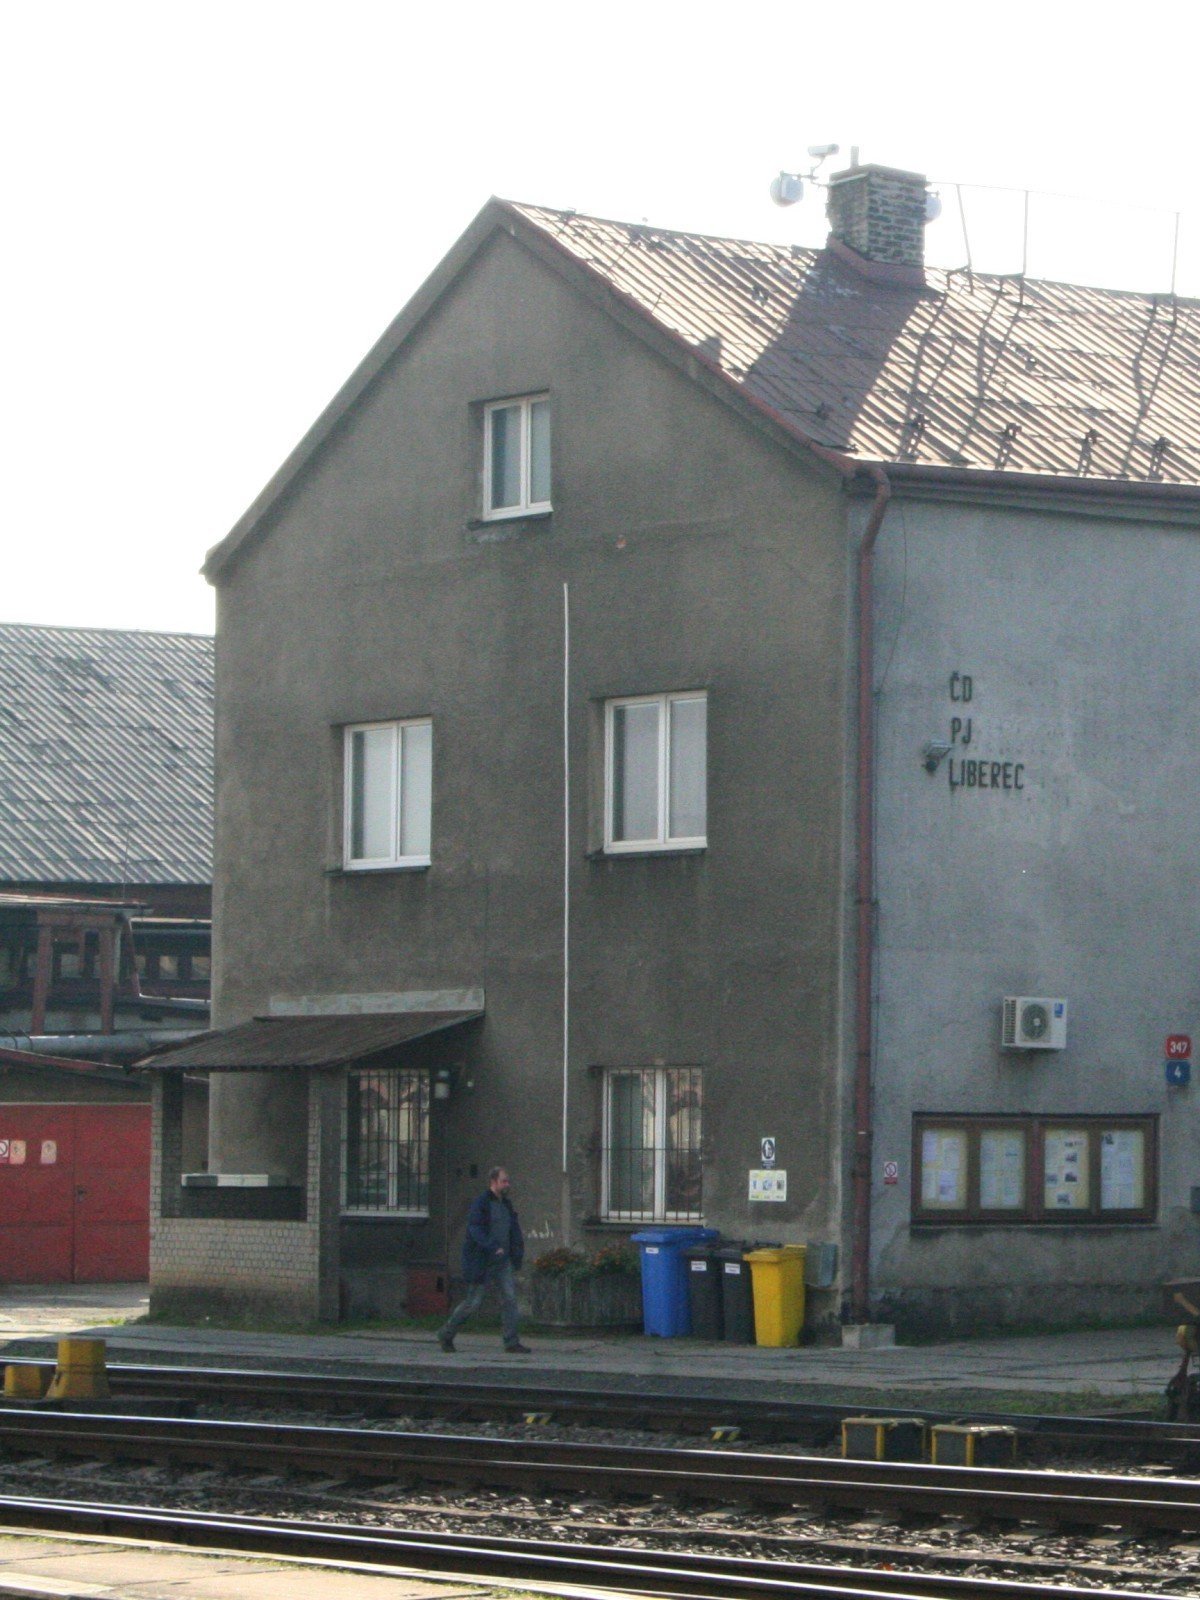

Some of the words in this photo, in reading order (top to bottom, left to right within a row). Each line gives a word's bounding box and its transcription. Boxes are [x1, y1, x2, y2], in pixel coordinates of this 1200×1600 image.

[949, 671, 972, 702] ČD
[951, 717, 972, 744] PJ
[949, 759, 1024, 790] LIBEREC
[1170, 1041, 1188, 1053] 347
[1174, 1066, 1182, 1078] 4
